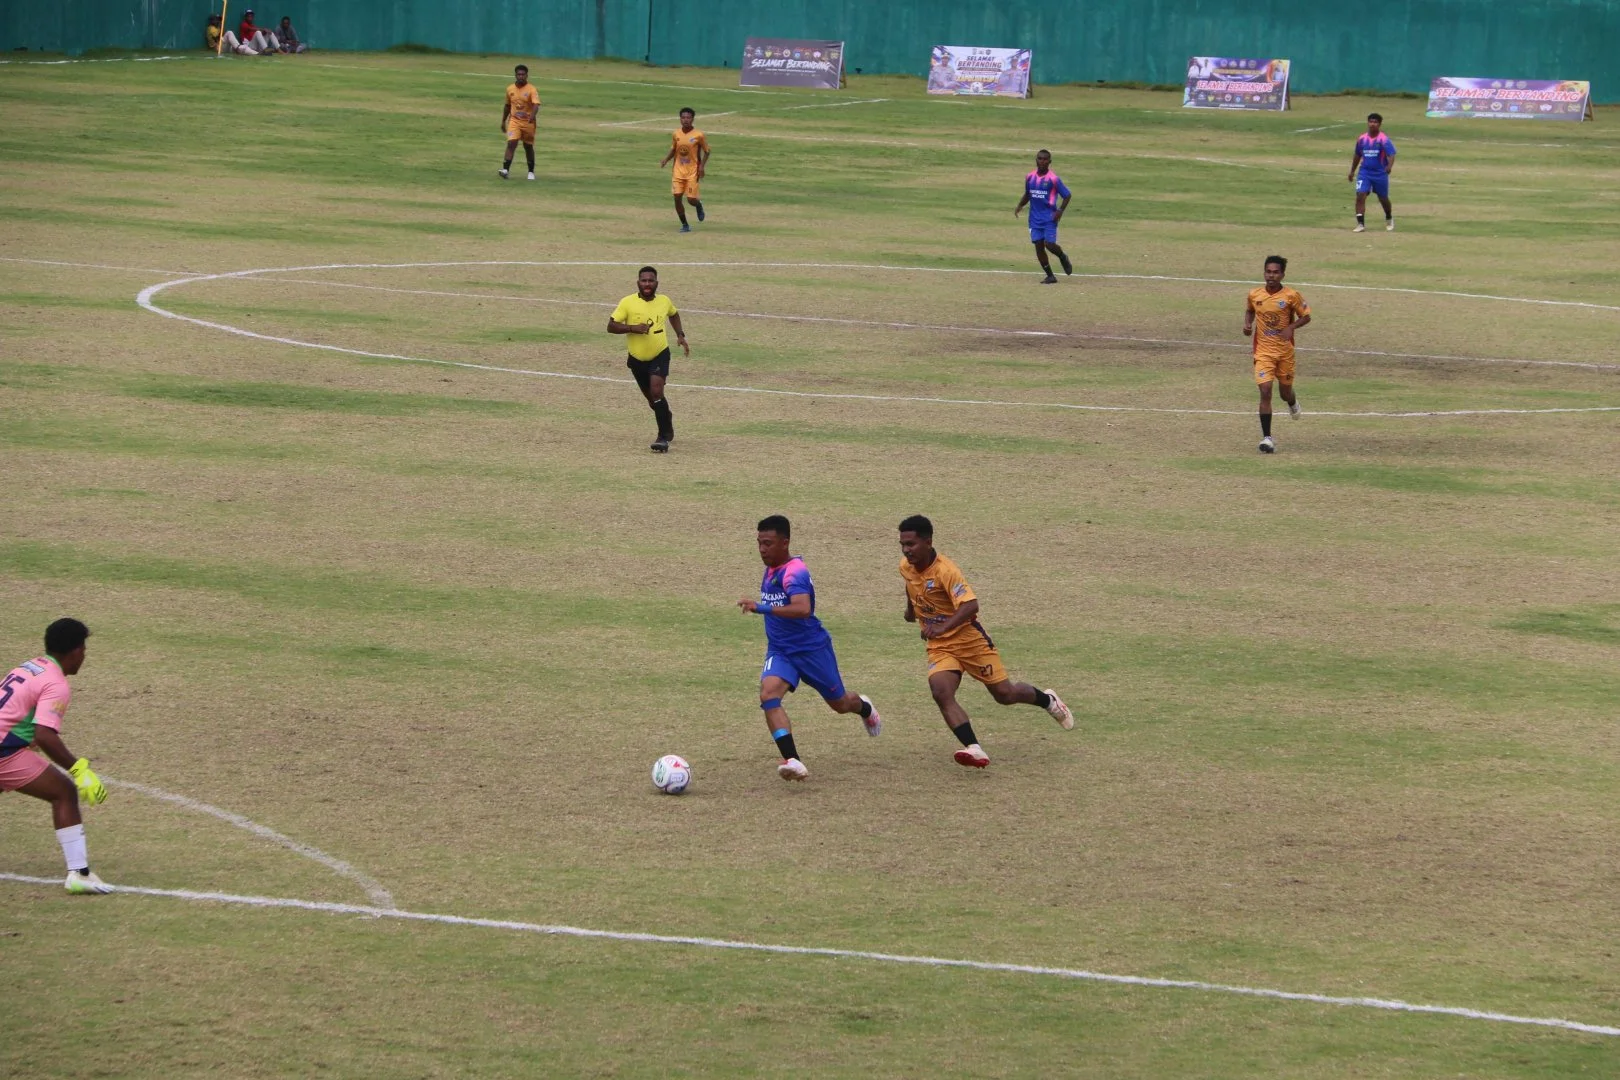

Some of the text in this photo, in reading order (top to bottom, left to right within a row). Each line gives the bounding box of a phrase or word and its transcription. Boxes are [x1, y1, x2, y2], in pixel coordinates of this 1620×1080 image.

[750, 59, 786, 69] SELAMAT
[786, 59, 831, 72] BERTANDING
[957, 60, 1002, 69] BERTANDING
[1196, 80, 1274, 93] SELAMAT BERTANDING
[1435, 87, 1581, 102] SELAMAT BERTANDING
[979, 664, 993, 677] 27
[0, 673, 25, 710] 5
